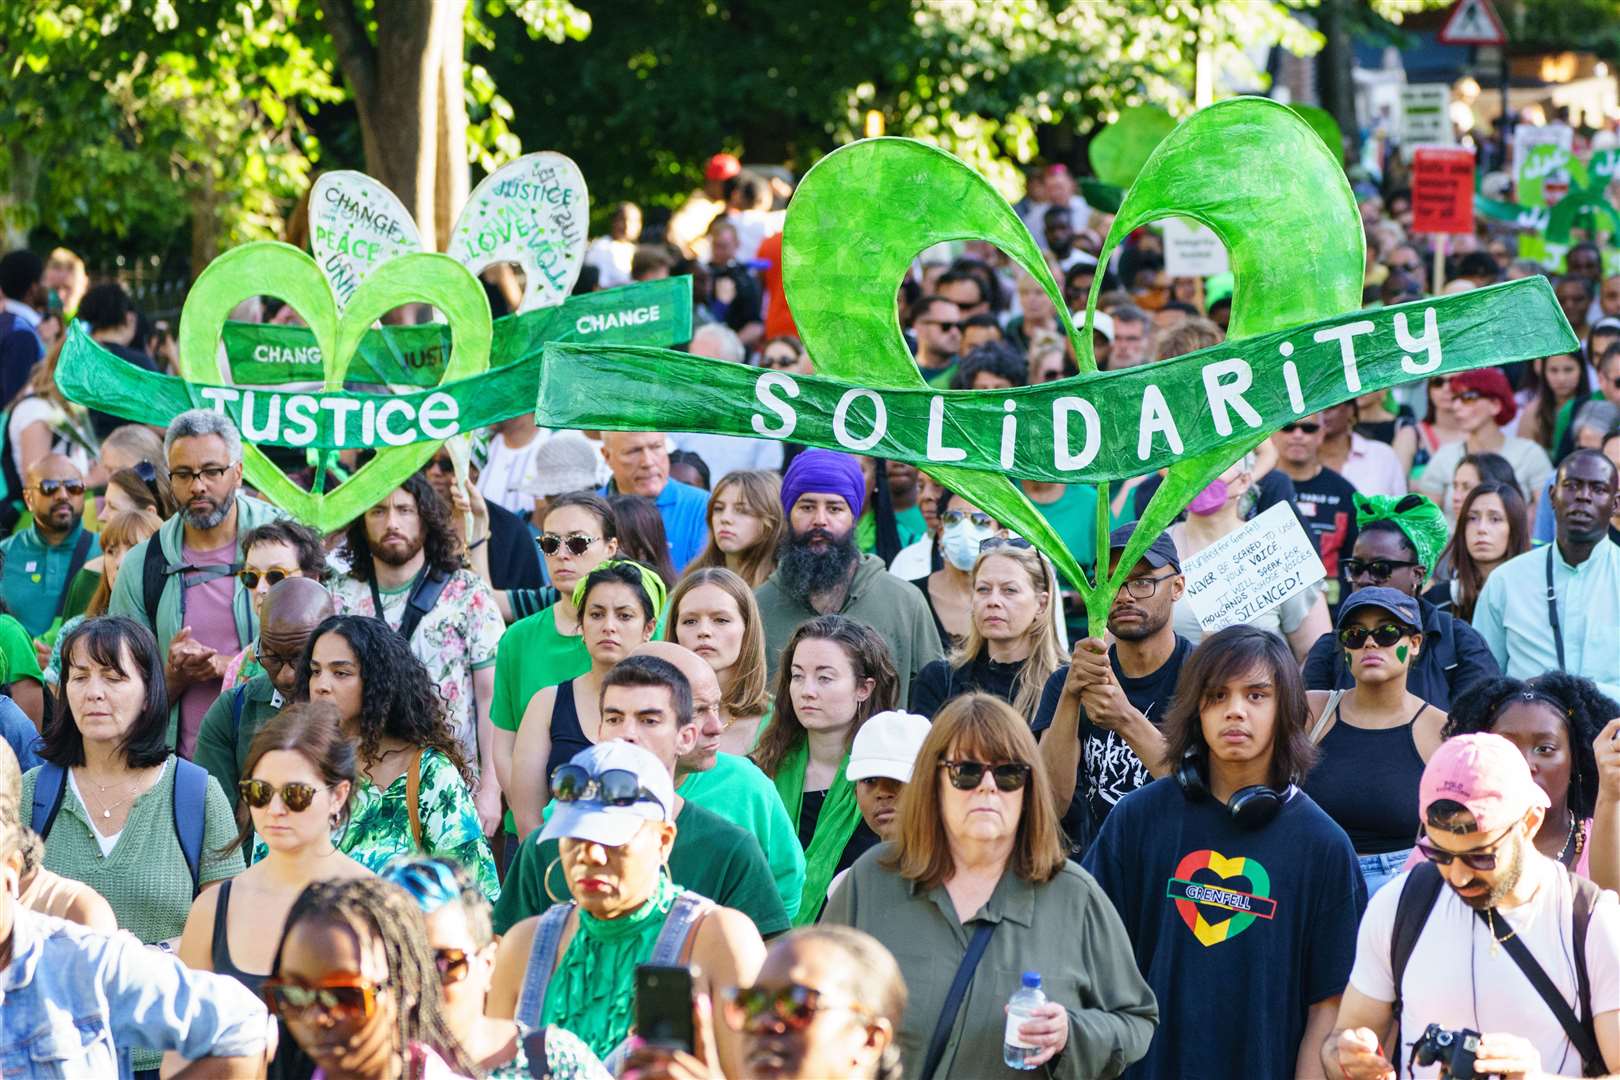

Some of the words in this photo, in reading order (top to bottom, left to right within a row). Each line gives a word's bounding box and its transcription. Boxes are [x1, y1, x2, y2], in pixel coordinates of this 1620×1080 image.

[493, 179, 573, 205] JUSTICE
[325, 187, 402, 235] CHANGE
[316, 224, 380, 261] PEACE
[466, 216, 530, 258] LOVE
[576, 305, 660, 334] CHANGE
[253, 345, 322, 364] CHANG
[1187, 571, 1217, 598] NEVER
[1217, 561, 1230, 575] BE
[1233, 541, 1261, 564] SCARED
[1262, 530, 1276, 541] TO
[1257, 558, 1282, 577] SPEAK
[1201, 591, 1248, 628] THOUSANDS
[1234, 571, 1303, 622] SILENCED!
[1185, 885, 1251, 911] GRENFELL
